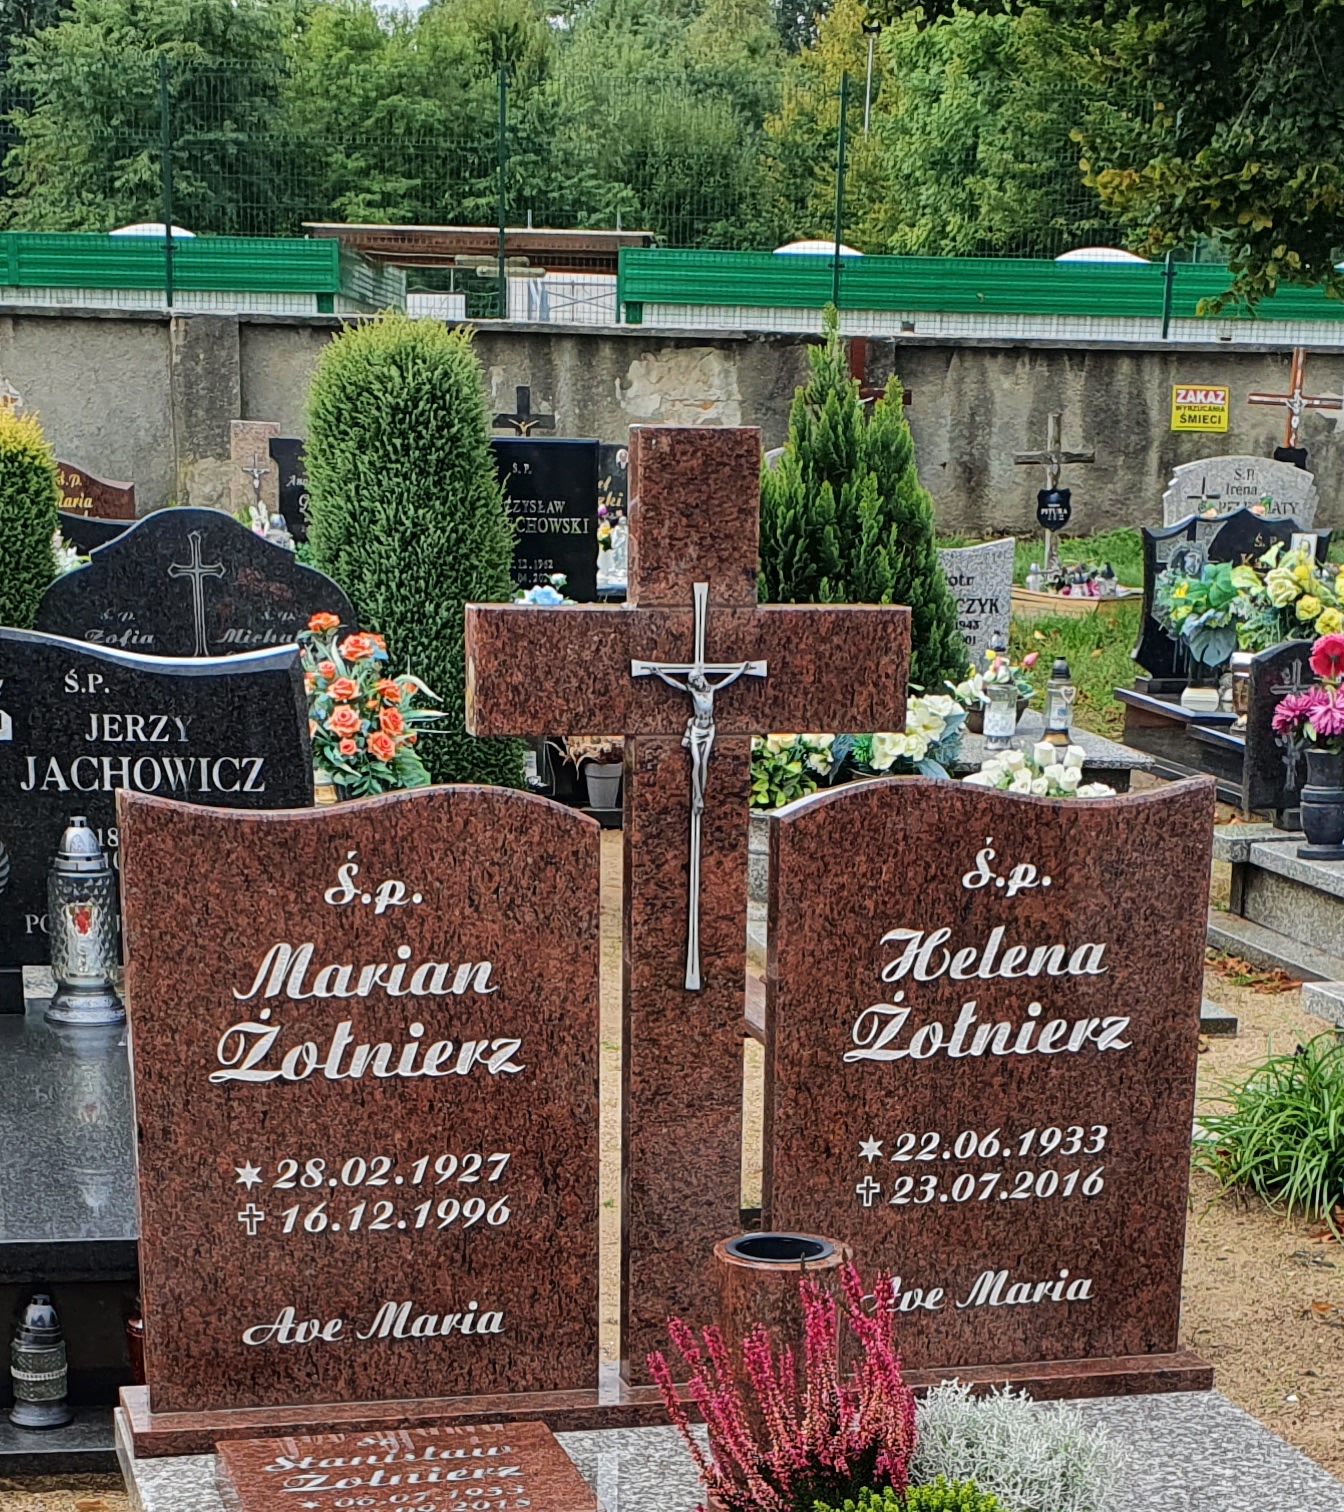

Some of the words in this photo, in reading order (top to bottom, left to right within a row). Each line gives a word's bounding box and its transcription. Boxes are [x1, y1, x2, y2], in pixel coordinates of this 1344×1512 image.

[1176, 389, 1225, 404] ZAKAZ
[1180, 412, 1221, 424] ŚMIECI
[1226, 484, 1258, 496] Irena
[511, 517, 590, 534] CHOWSKI
[946, 575, 974, 587] otr
[956, 598, 1000, 614] CZYK
[84, 629, 156, 645] Zofia
[85, 713, 192, 742] JERZY
[20, 755, 266, 792] JACHOWICZ
[323, 851, 423, 914] Ś.p.
[962, 837, 1052, 897] Ś.p.
[232, 942, 499, 1000] Marian
[879, 924, 1109, 984] Helena
[208, 1007, 525, 1084] Żołnierz
[842, 990, 1133, 1063] Żołnierz
[891, 1124, 1108, 1162] 22.06.1933
[272, 1152, 511, 1190] 28.02.1927
[889, 1166, 1106, 1205] 23.07.2016
[281, 1195, 511, 1234] 16.12.1996
[956, 1268, 1095, 1307] Maria
[242, 1305, 345, 1346] Ave
[357, 1300, 506, 1341] Maria
[264, 1445, 512, 1472] Stanisław
[280, 1465, 525, 1492] Żołnierz
